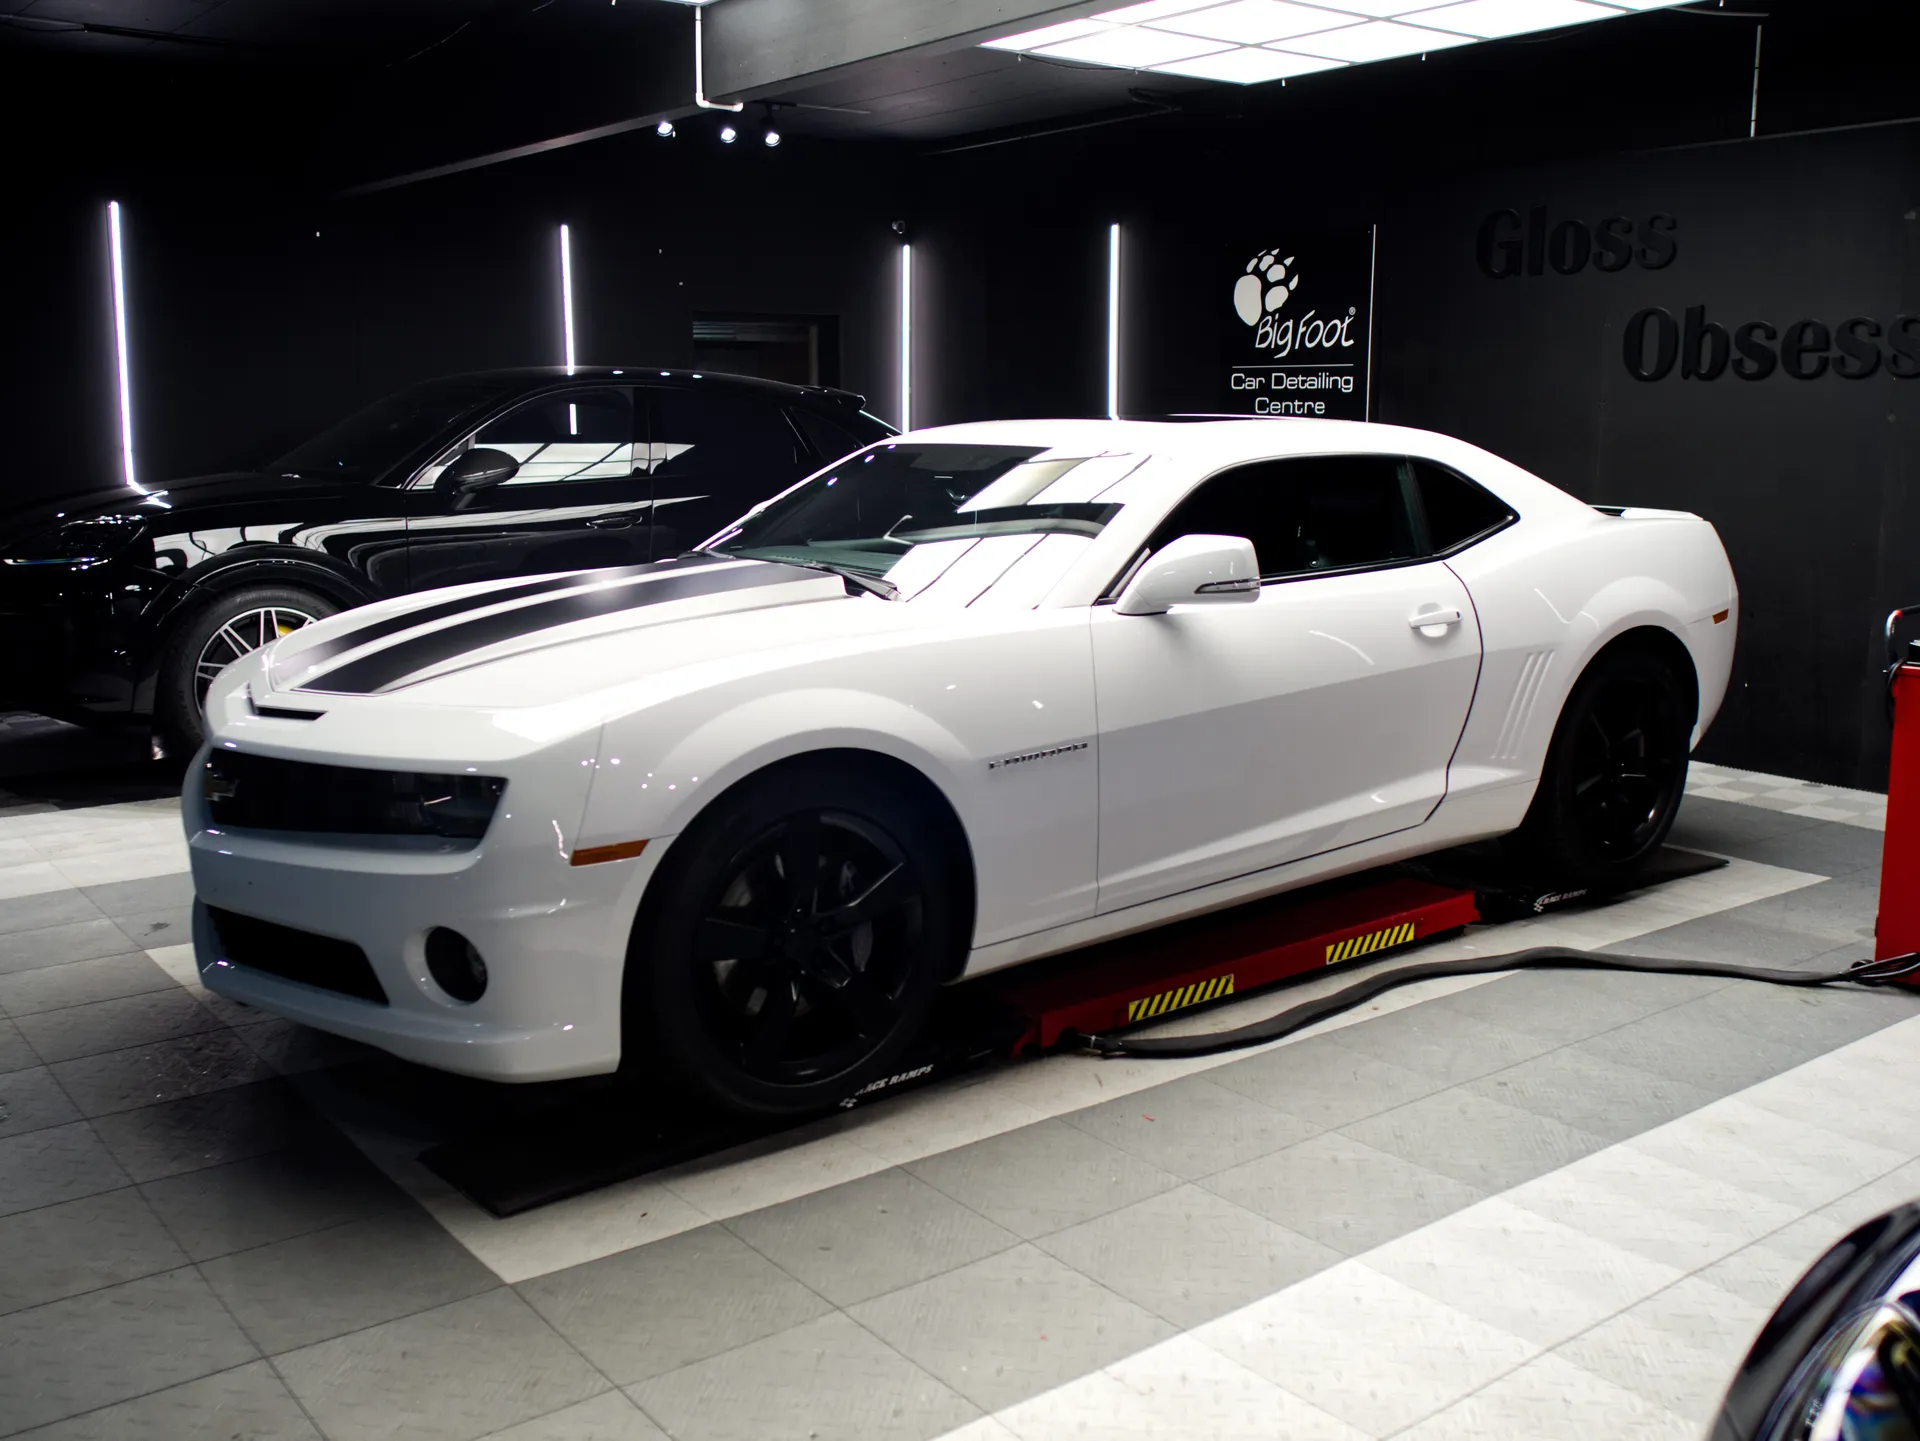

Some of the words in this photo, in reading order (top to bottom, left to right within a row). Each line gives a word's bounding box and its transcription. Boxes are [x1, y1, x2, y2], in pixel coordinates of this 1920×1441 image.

[1476, 203, 1678, 279] Gloss
[1231, 373, 1265, 390] Car
[1271, 372, 1354, 393] Detailing
[1255, 397, 1325, 414] Centre
